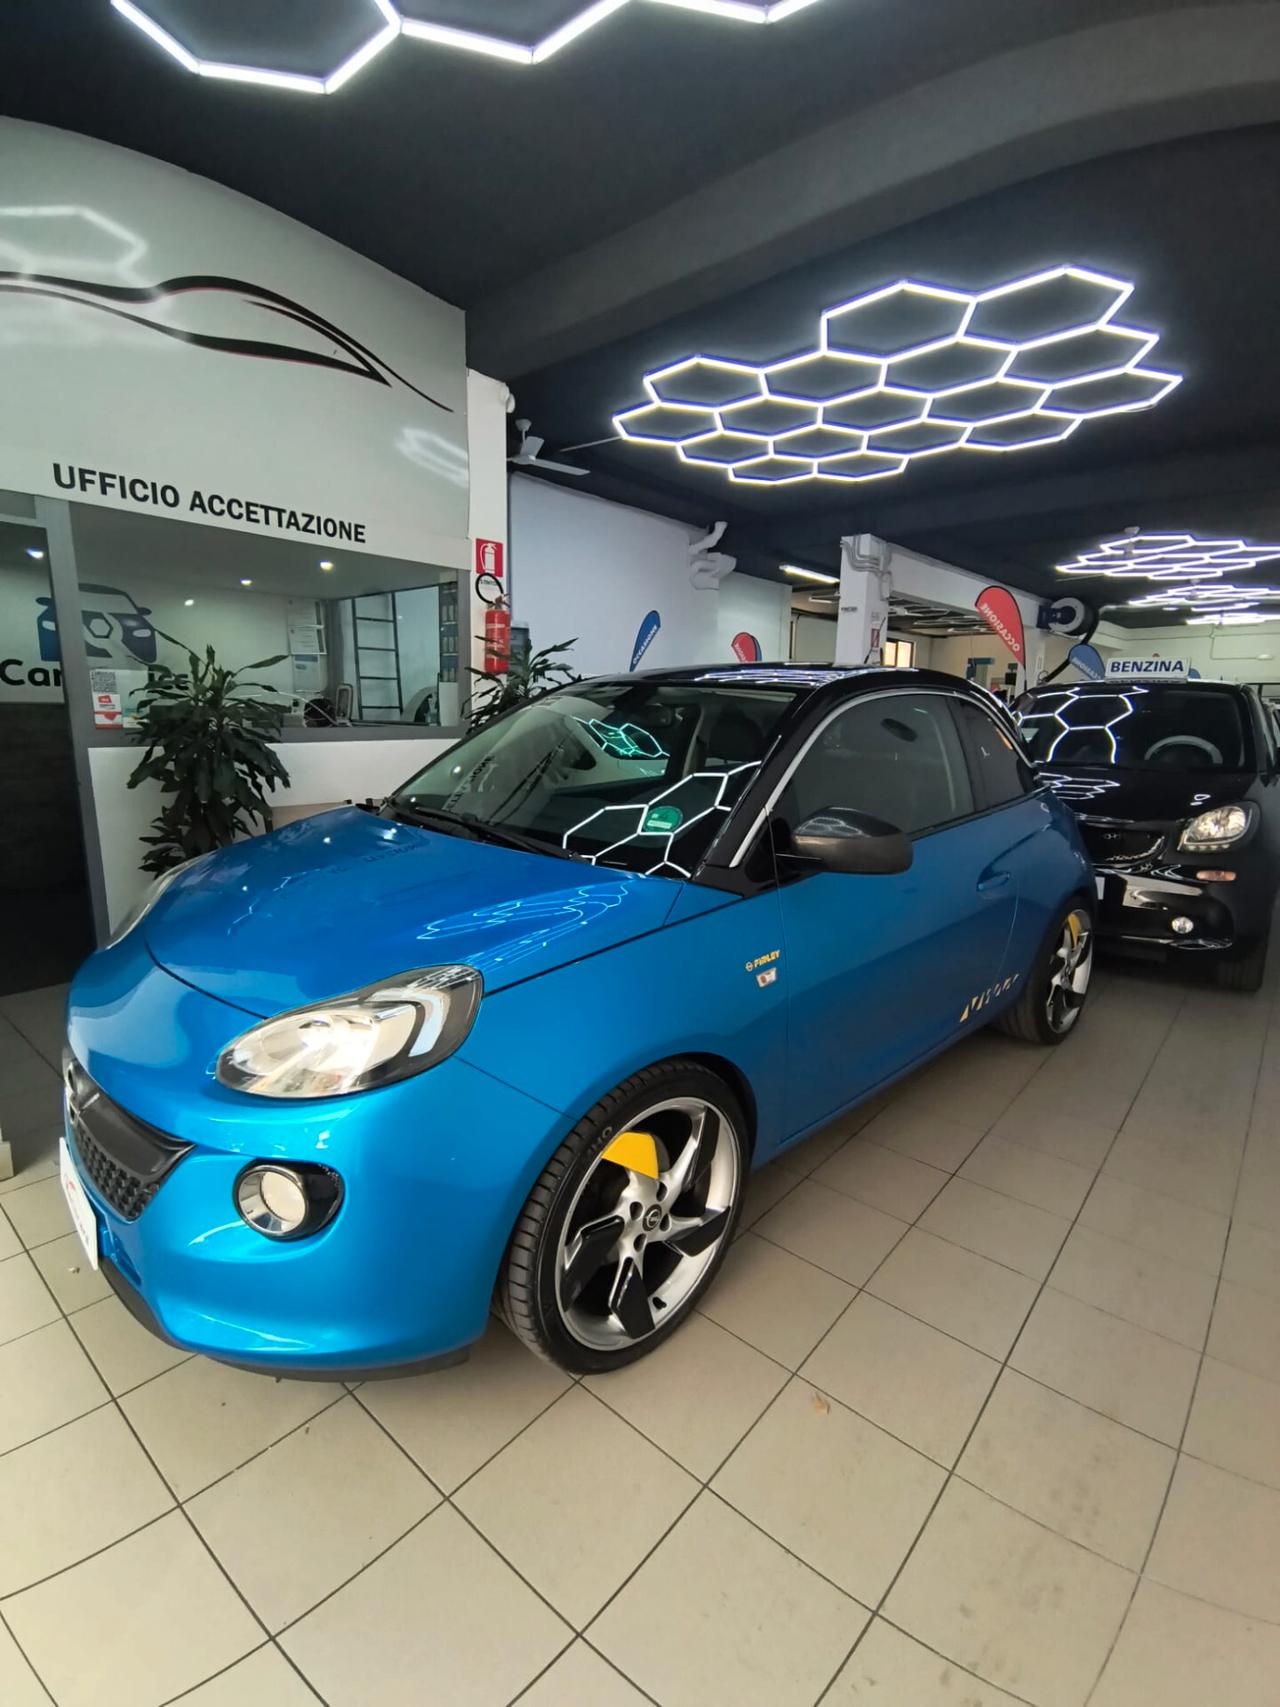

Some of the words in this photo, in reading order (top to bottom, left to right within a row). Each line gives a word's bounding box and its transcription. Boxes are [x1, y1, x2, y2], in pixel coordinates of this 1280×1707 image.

[53, 463, 180, 508] UFFICIO
[189, 490, 366, 544] ACCETTAZIONE
[1110, 660, 1184, 673] BENZINA
